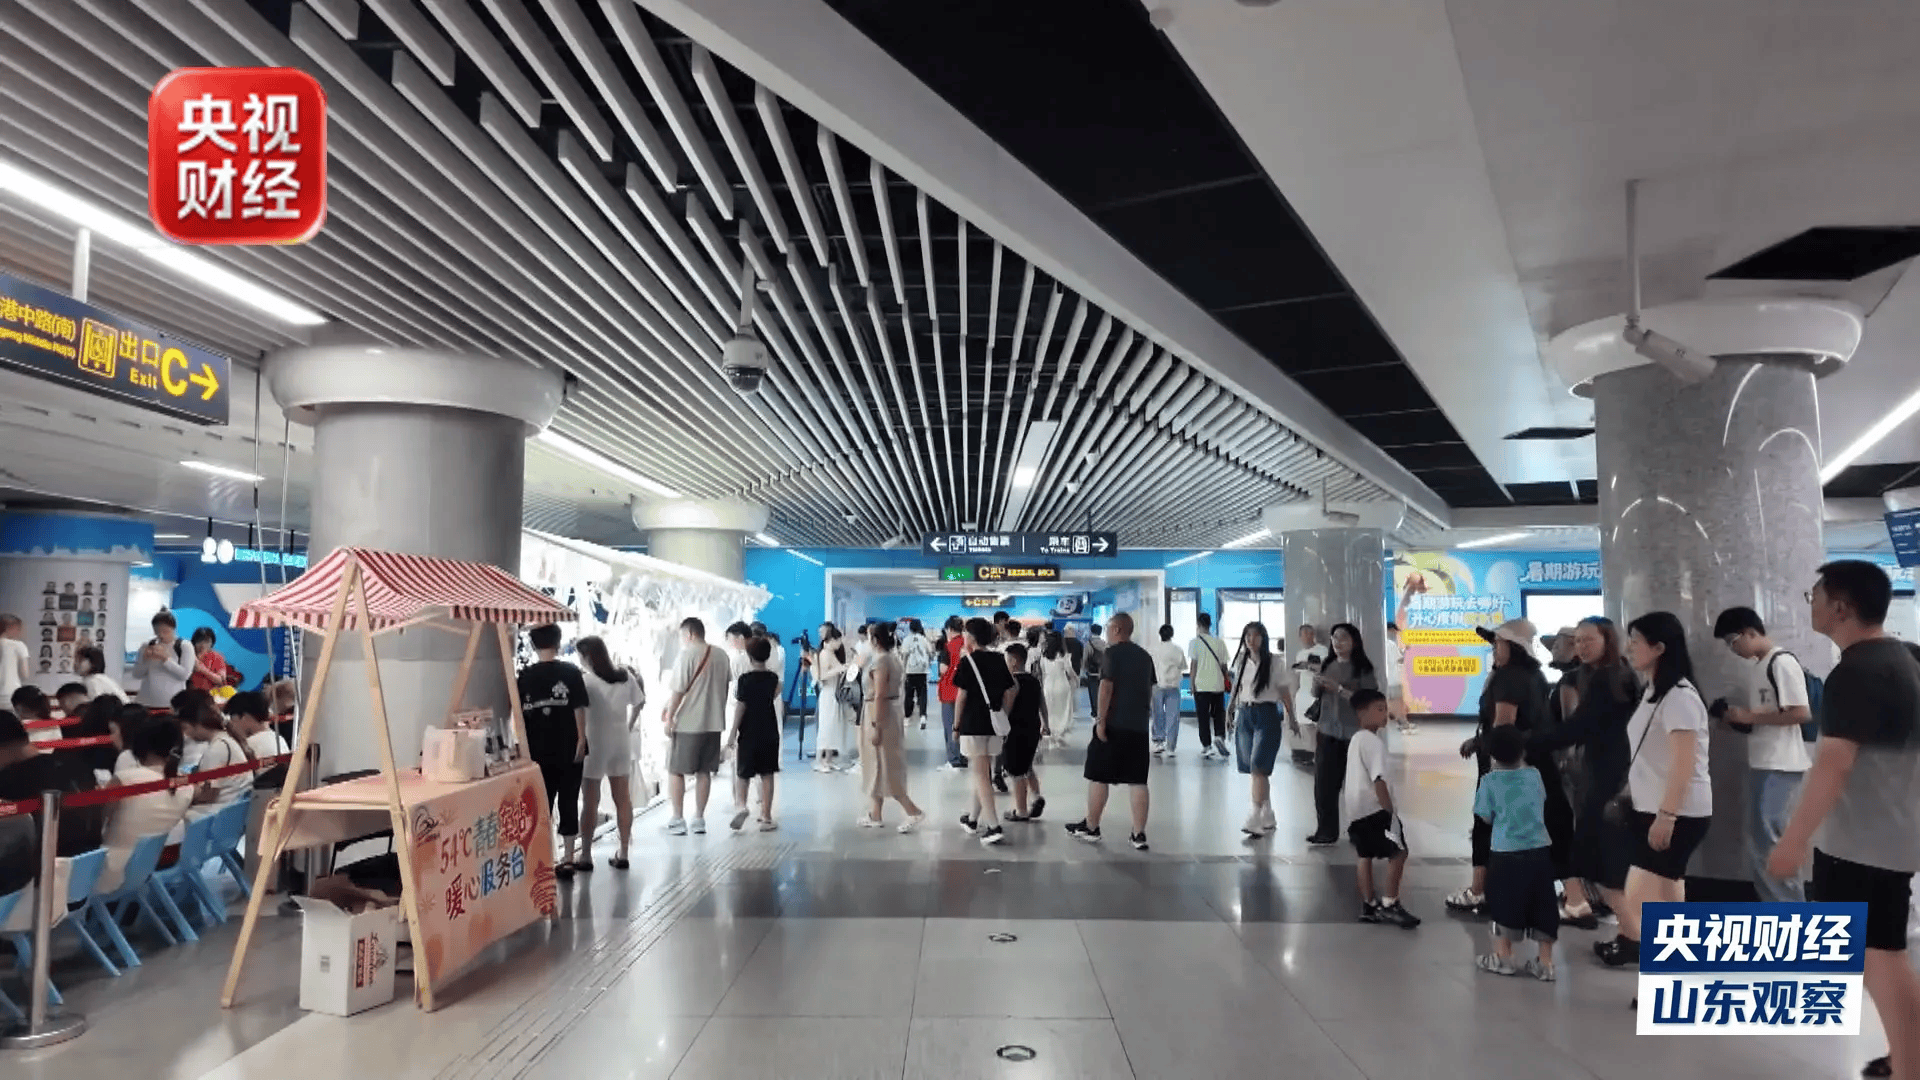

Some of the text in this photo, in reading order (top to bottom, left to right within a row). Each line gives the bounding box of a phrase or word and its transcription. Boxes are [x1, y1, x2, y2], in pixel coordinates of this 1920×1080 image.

[119, 330, 161, 369] 出口
[130, 367, 158, 391] Exit
[161, 347, 189, 397] C
[1520, 561, 1602, 582] 暑期游玩
[446, 845, 525, 921] 暖心服务台
